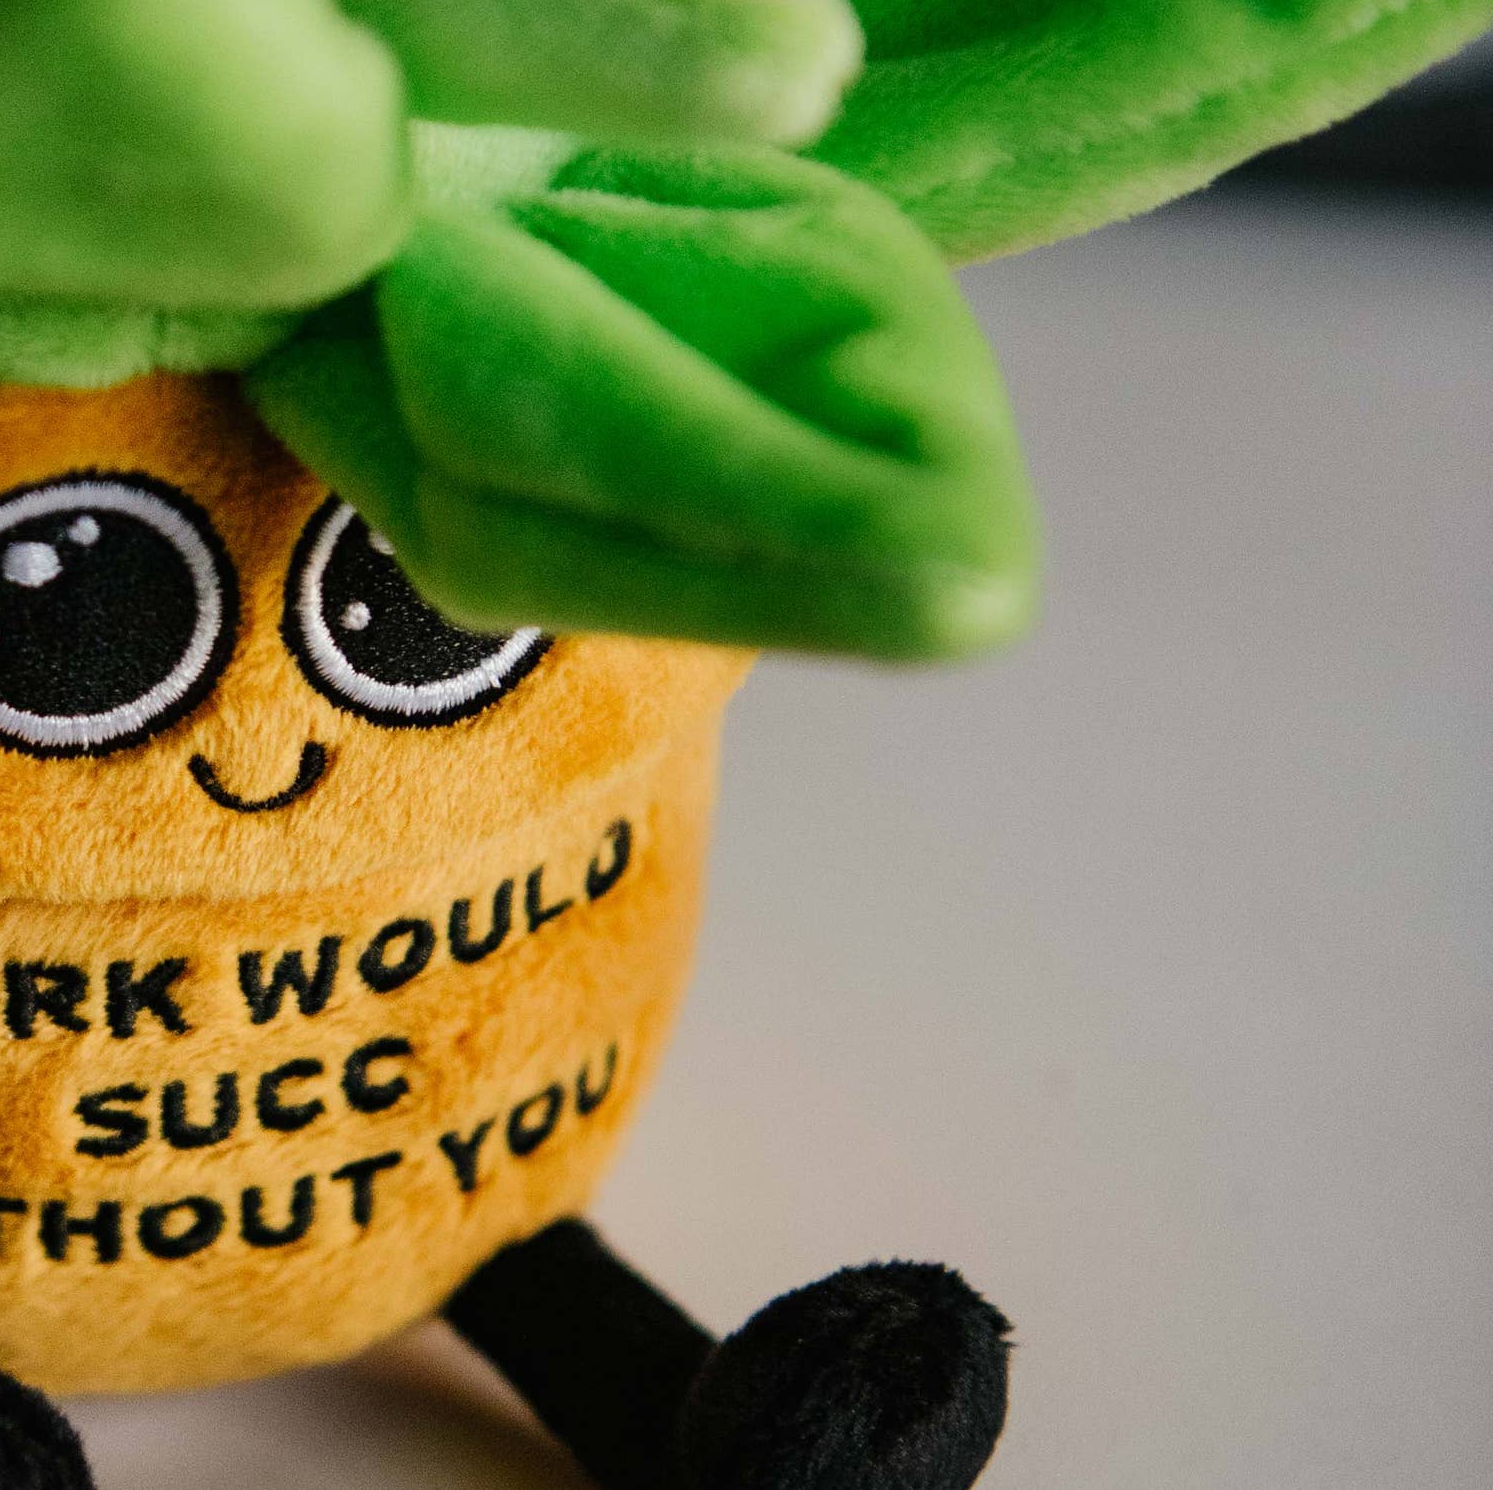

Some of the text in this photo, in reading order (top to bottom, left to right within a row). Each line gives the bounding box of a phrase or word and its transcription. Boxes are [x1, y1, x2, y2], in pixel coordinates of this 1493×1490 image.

[238, 817, 633, 1023] WOULD
[74, 1036, 414, 1159] SUCC
[438, 1043, 620, 1193] YOU
